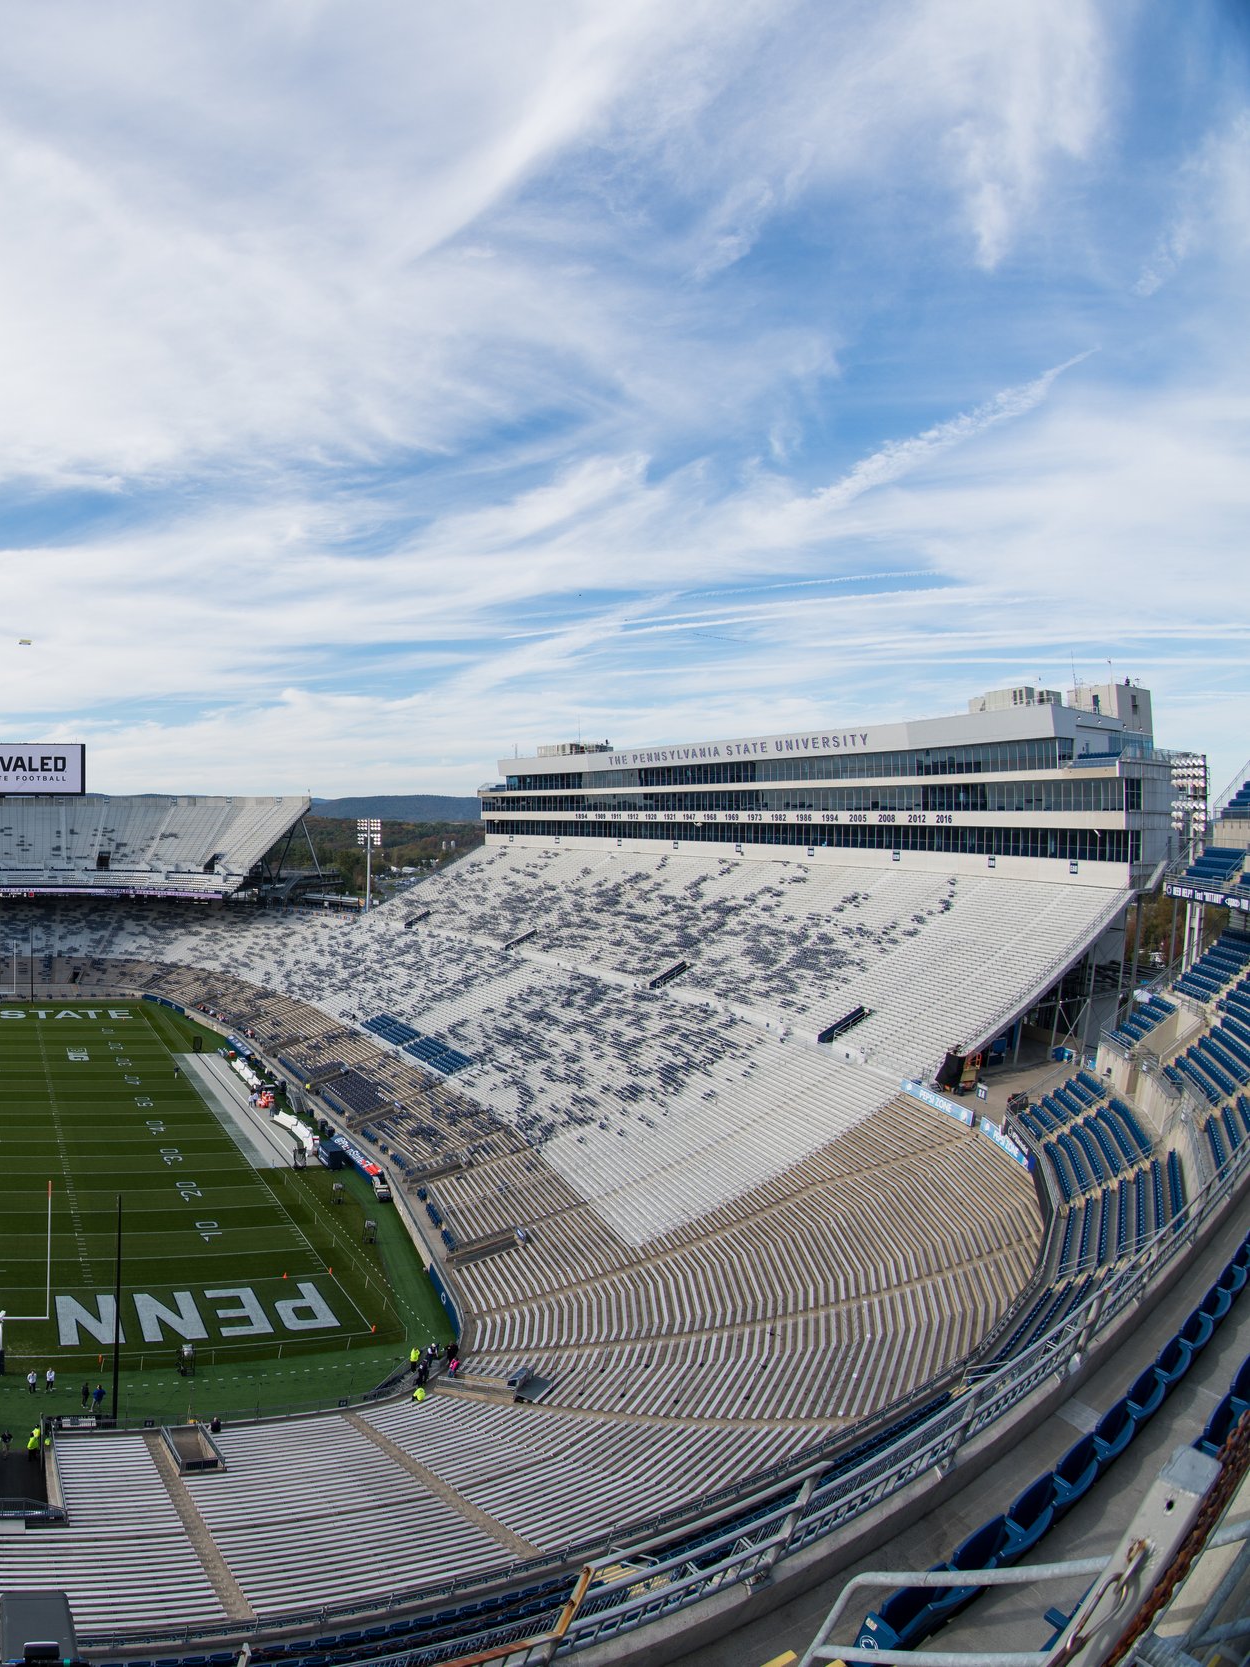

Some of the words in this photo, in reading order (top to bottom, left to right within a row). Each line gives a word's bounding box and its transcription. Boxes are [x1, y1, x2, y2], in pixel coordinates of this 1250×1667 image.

[608, 755, 628, 766] THE
[633, 747, 721, 765] PENNSYLVANIA
[726, 741, 768, 756] STATE
[775, 733, 869, 752] UNIVERSITY
[682, 813, 696, 821] 1947
[724, 813, 739, 821] 1969
[770, 814, 787, 822] 1982
[796, 814, 812, 822] 1986
[821, 814, 839, 822] 1994
[849, 814, 867, 823] 2005
[878, 814, 896, 823] 2008
[908, 814, 927, 823] 2012
[935, 814, 953, 824] 2016
[0, 1009, 134, 1020] STATE
[134, 1096, 154, 1107] 50
[918, 1089, 936, 1103] PEPSI
[935, 1097, 952, 1113] ZONE
[146, 1120, 167, 1133] 40
[159, 1148, 183, 1162] 30
[1004, 1138, 1020, 1158] ZONE
[175, 1181, 203, 1198] 20
[195, 1221, 223, 1236] 10
[54, 1281, 342, 1347] PENN
